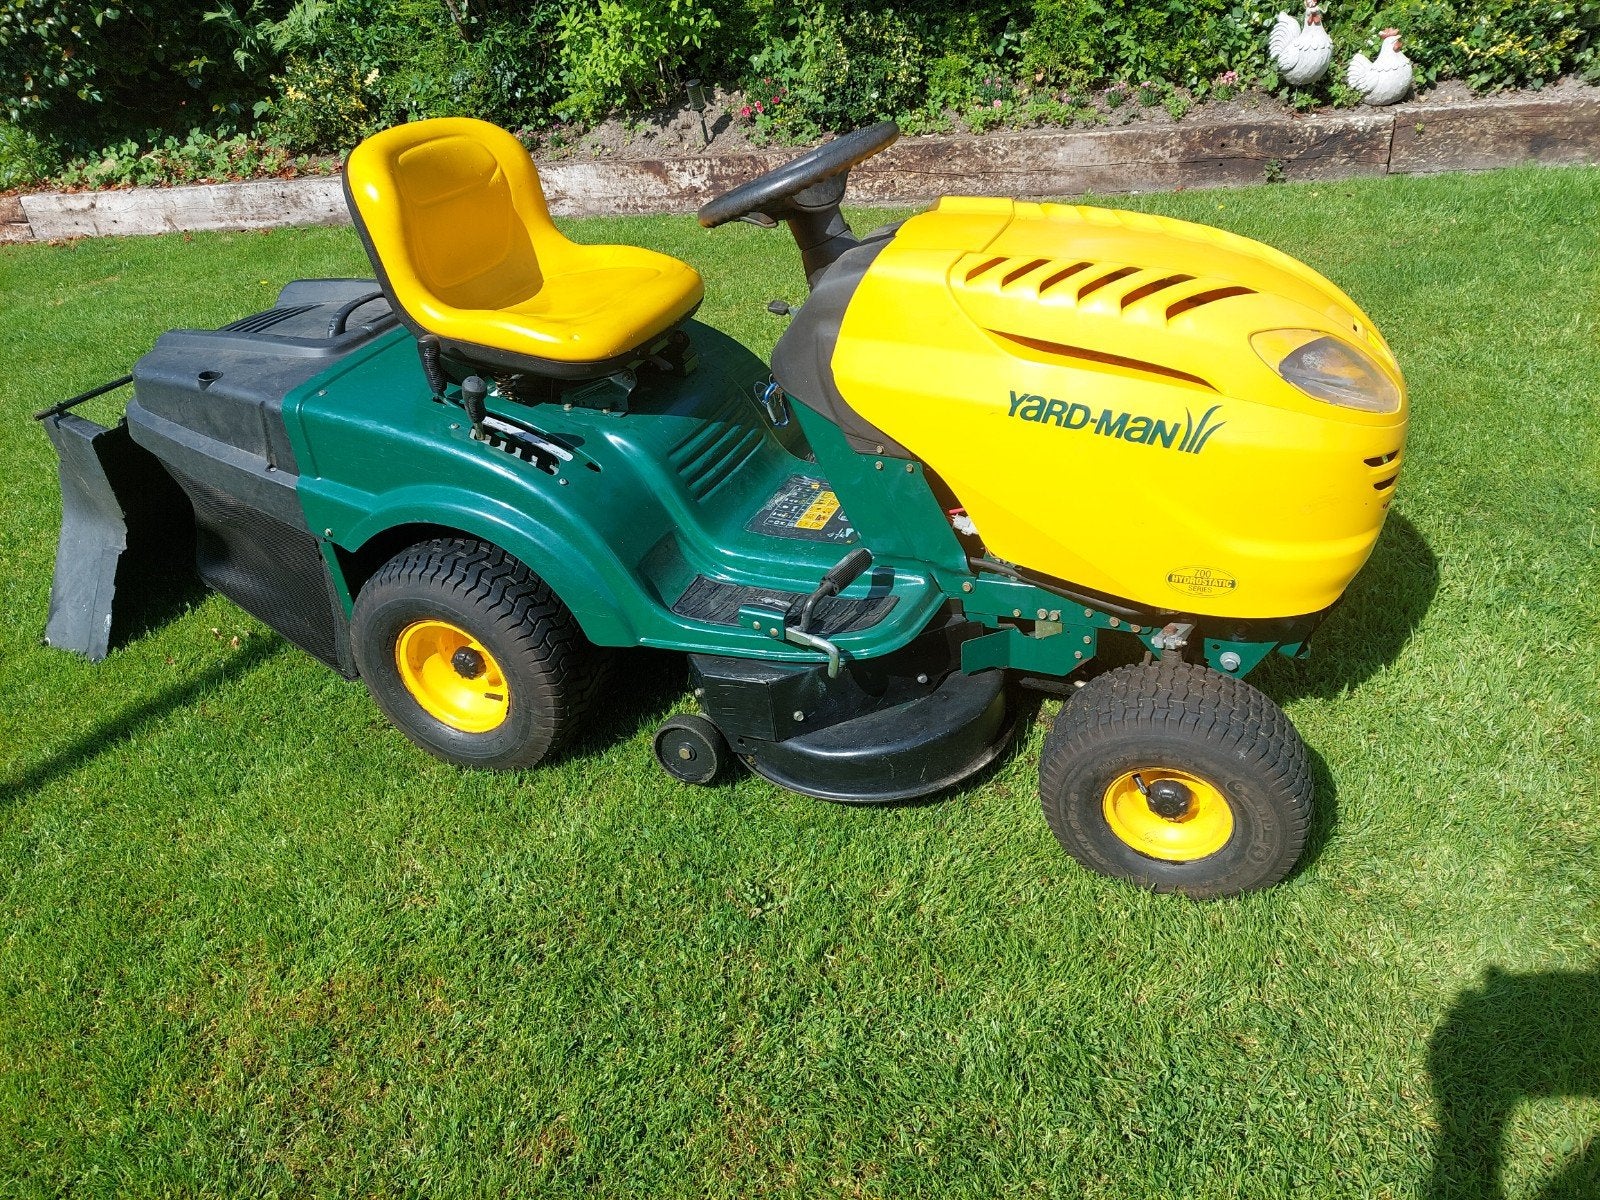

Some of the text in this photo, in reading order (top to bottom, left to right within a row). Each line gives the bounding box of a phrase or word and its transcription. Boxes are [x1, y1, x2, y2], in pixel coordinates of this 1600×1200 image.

[1194, 569, 1211, 578] 700
[1171, 575, 1233, 588] HYDROSTATIC
[1188, 585, 1213, 593] SERIES
